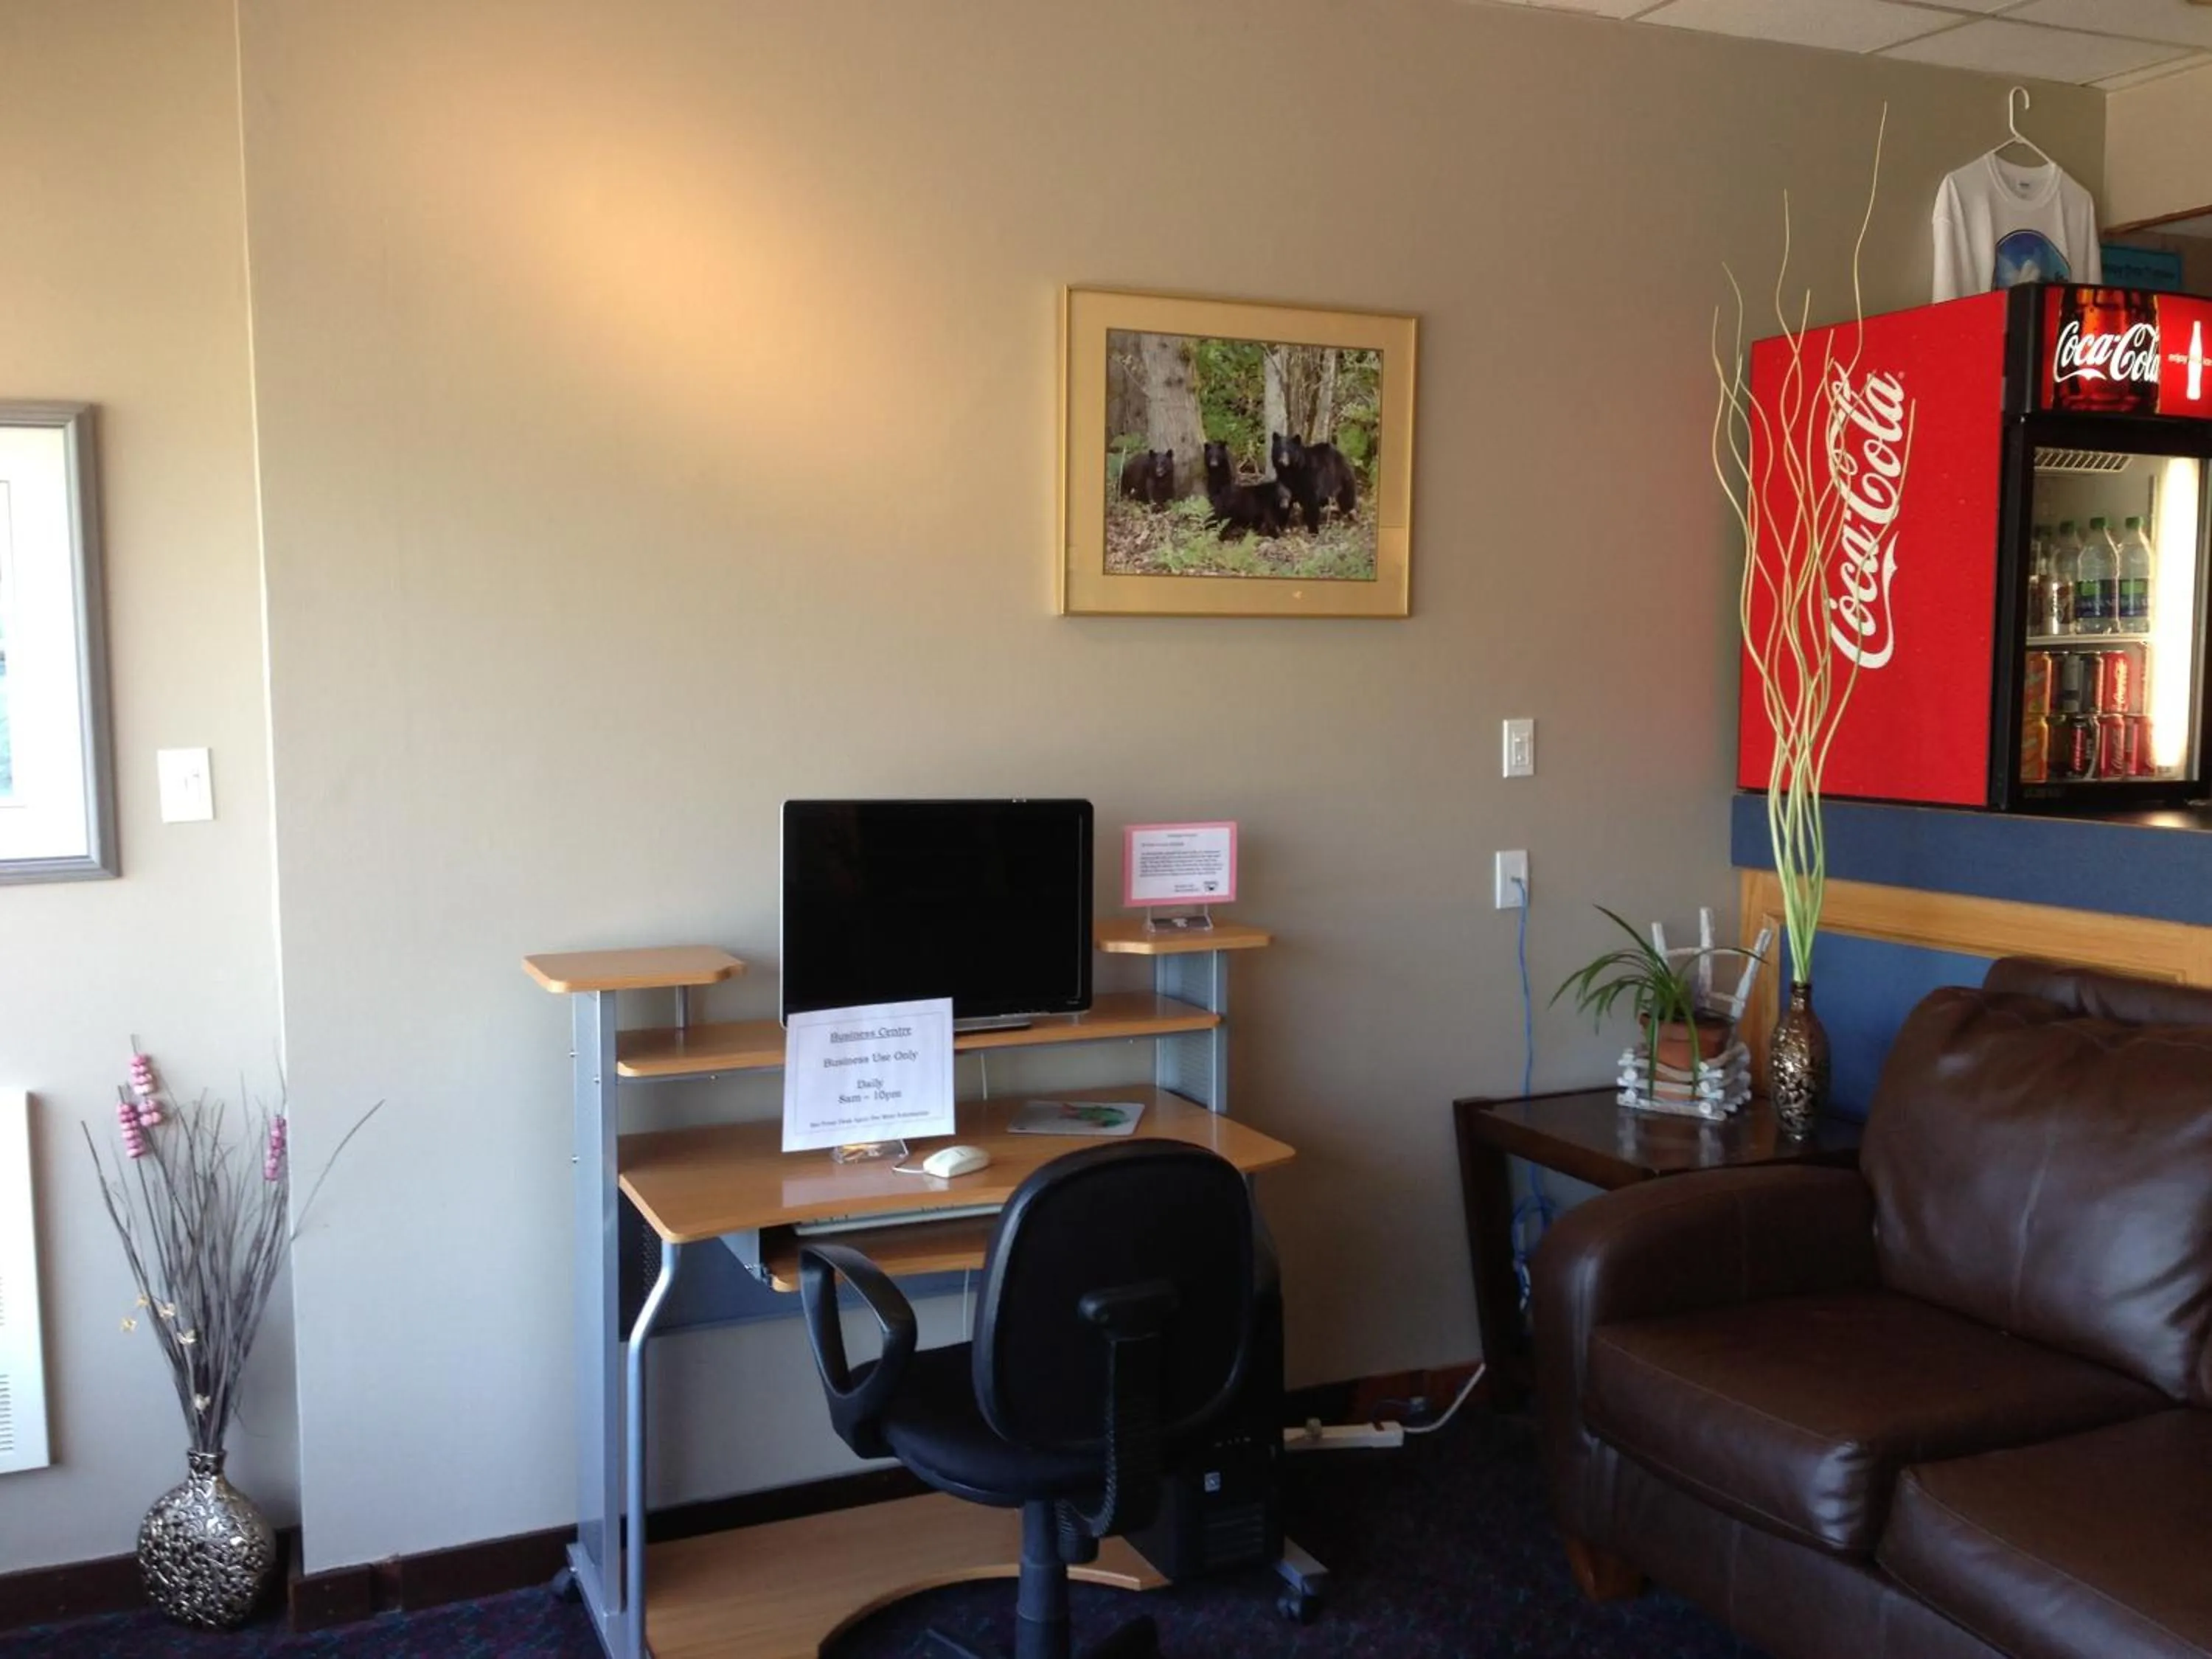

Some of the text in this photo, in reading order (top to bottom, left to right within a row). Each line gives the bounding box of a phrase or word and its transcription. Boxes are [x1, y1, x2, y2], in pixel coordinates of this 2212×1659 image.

[2053, 321, 2160, 383] Coca-Cola
[1829, 358, 1905, 669] Coca-Cola
[830, 1027, 912, 1043] Business Centre
[824, 1050, 919, 1068] Business Use Only
[857, 1078, 884, 1090] Daily
[873, 1090, 902, 1102] 10pm
